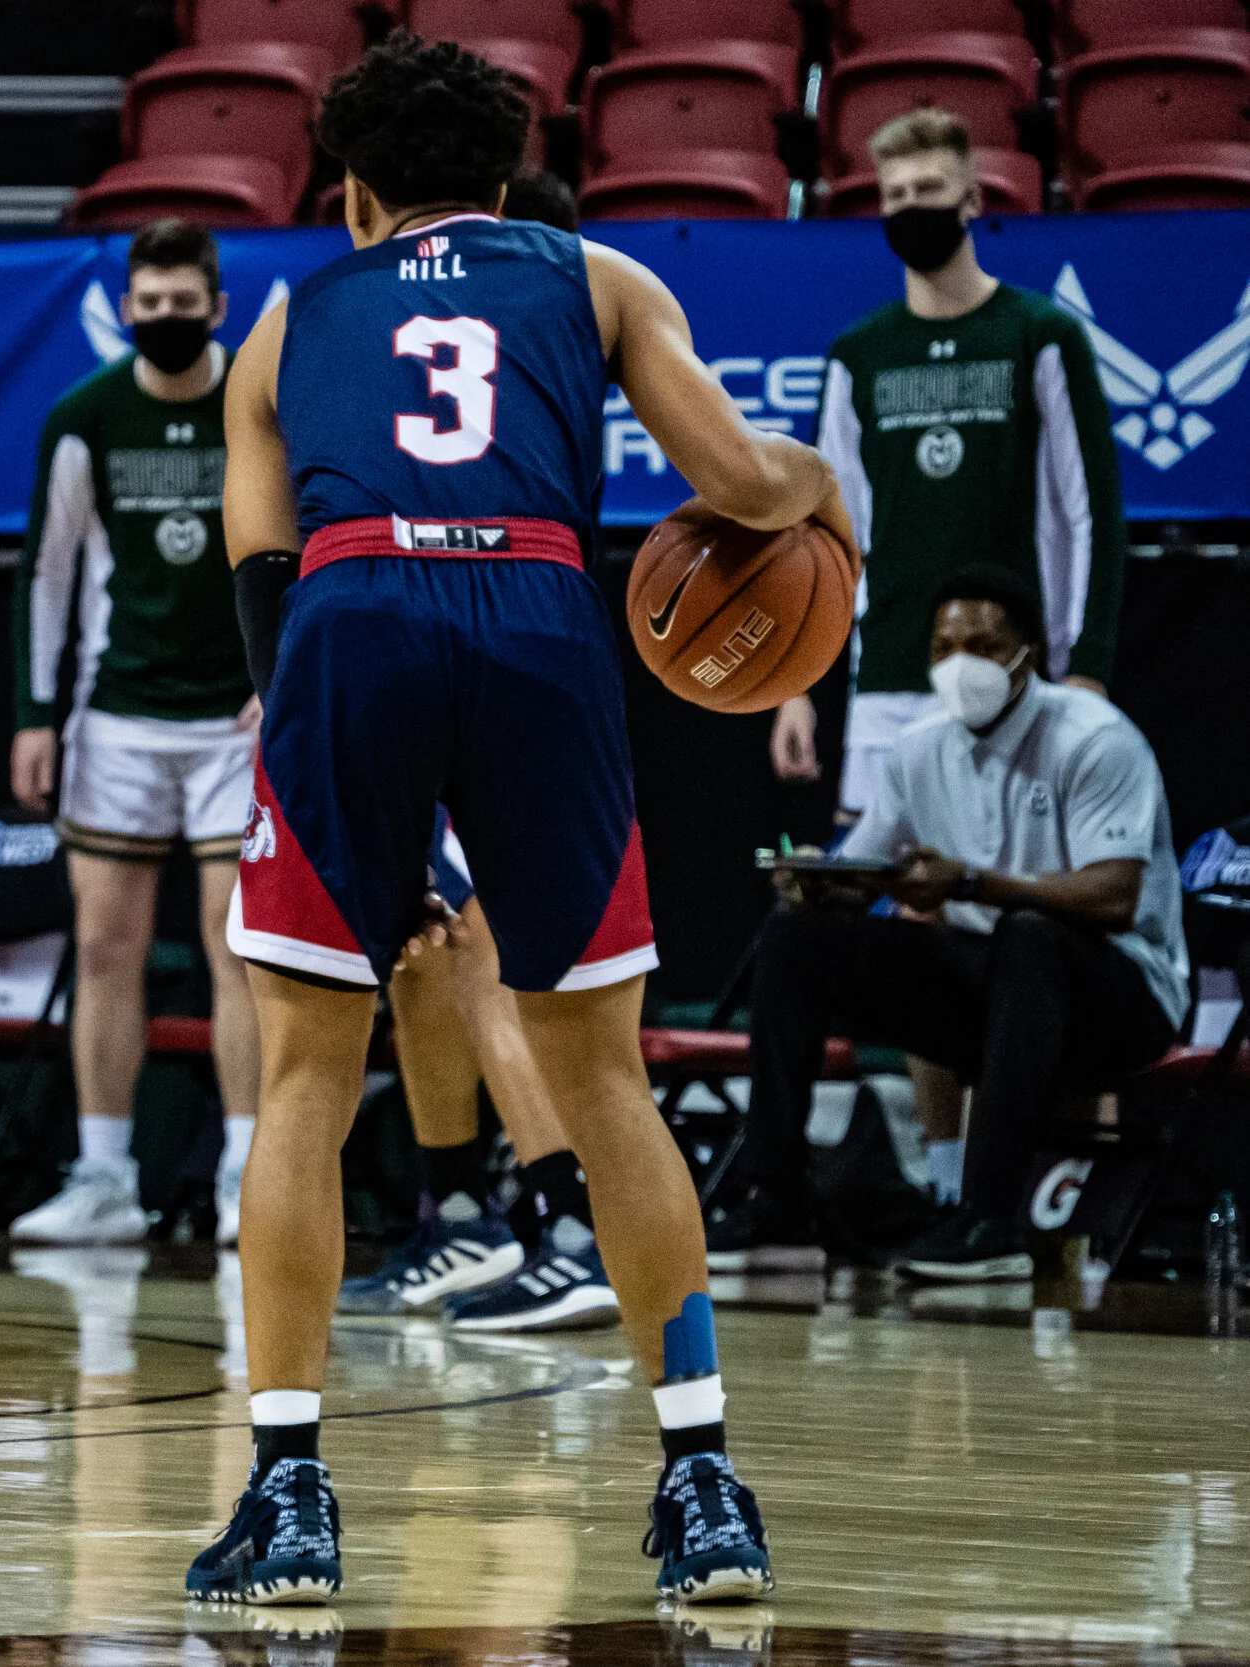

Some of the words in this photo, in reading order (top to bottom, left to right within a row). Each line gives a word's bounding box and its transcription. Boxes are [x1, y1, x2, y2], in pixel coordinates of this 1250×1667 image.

[399, 253, 466, 281] HILL
[393, 314, 499, 465] 3
[690, 606, 775, 689] ELITE
[1030, 1157, 1094, 1231] G
